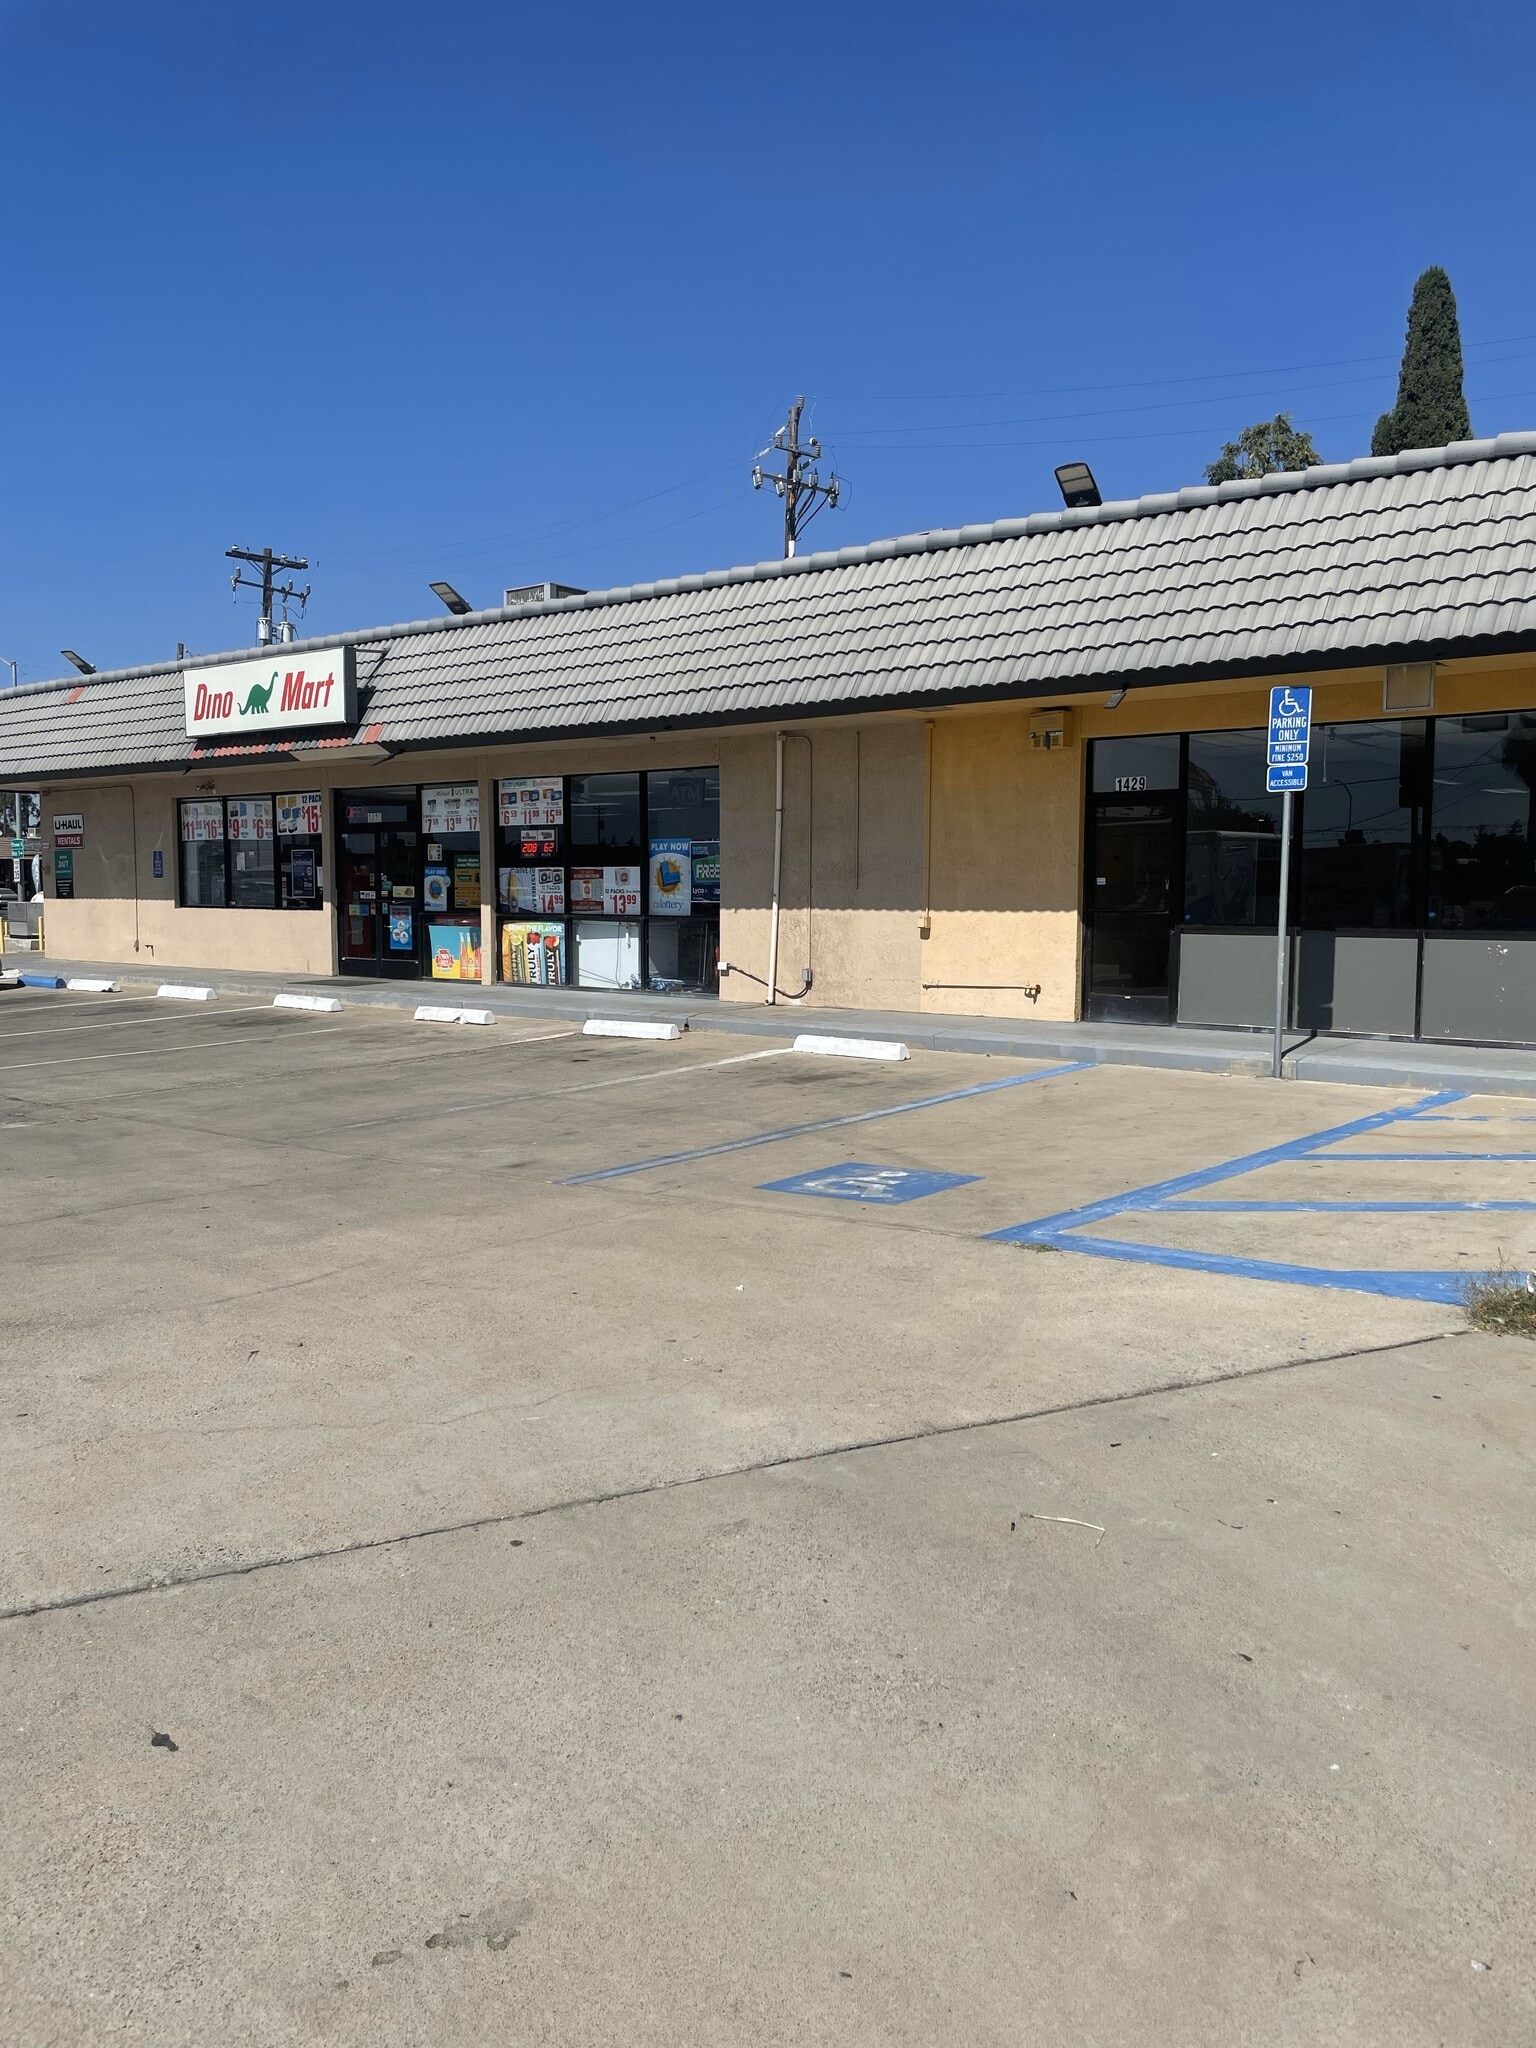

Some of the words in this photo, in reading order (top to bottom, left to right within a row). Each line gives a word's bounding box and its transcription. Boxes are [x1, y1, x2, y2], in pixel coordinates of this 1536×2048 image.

[193, 683, 234, 721] Dino
[280, 671, 335, 712] Mart
[1272, 717, 1307, 729] PARKING
[1278, 729, 1299, 741] ONLY
[1275, 744, 1302, 752] MINIMUM
[1272, 754, 1285, 762] FINE
[1286, 753, 1304, 762] $250
[1117, 777, 1145, 791] 1429
[1270, 778, 1304, 787] ACCESSIBLE
[455, 788, 474, 796] ULTRA
[58, 836, 81, 846] RENTALS
[543, 842, 555, 853] 62
[651, 843, 668, 851] PLAY
[670, 842, 689, 851] NOW
[58, 860, 69, 868] 24/7
[696, 864, 720, 878] FREE
[546, 949, 556, 985] TRULY
